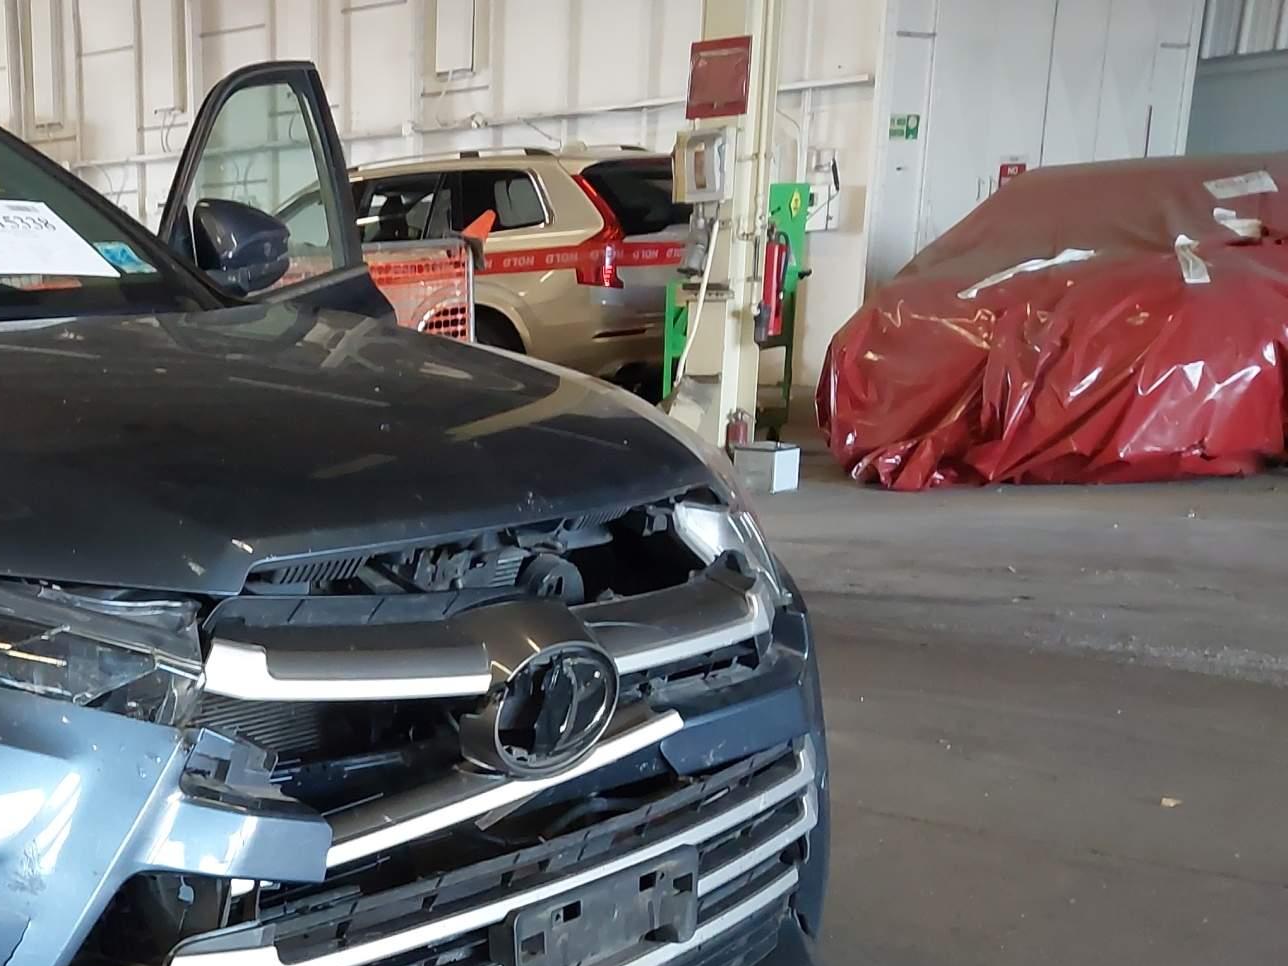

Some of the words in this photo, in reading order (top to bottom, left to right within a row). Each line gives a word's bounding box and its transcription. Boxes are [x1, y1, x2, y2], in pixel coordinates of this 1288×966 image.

[1007, 166, 1018, 175] NO
[502, 255, 535, 268] HOLD
[546, 252, 579, 264] HOLD
